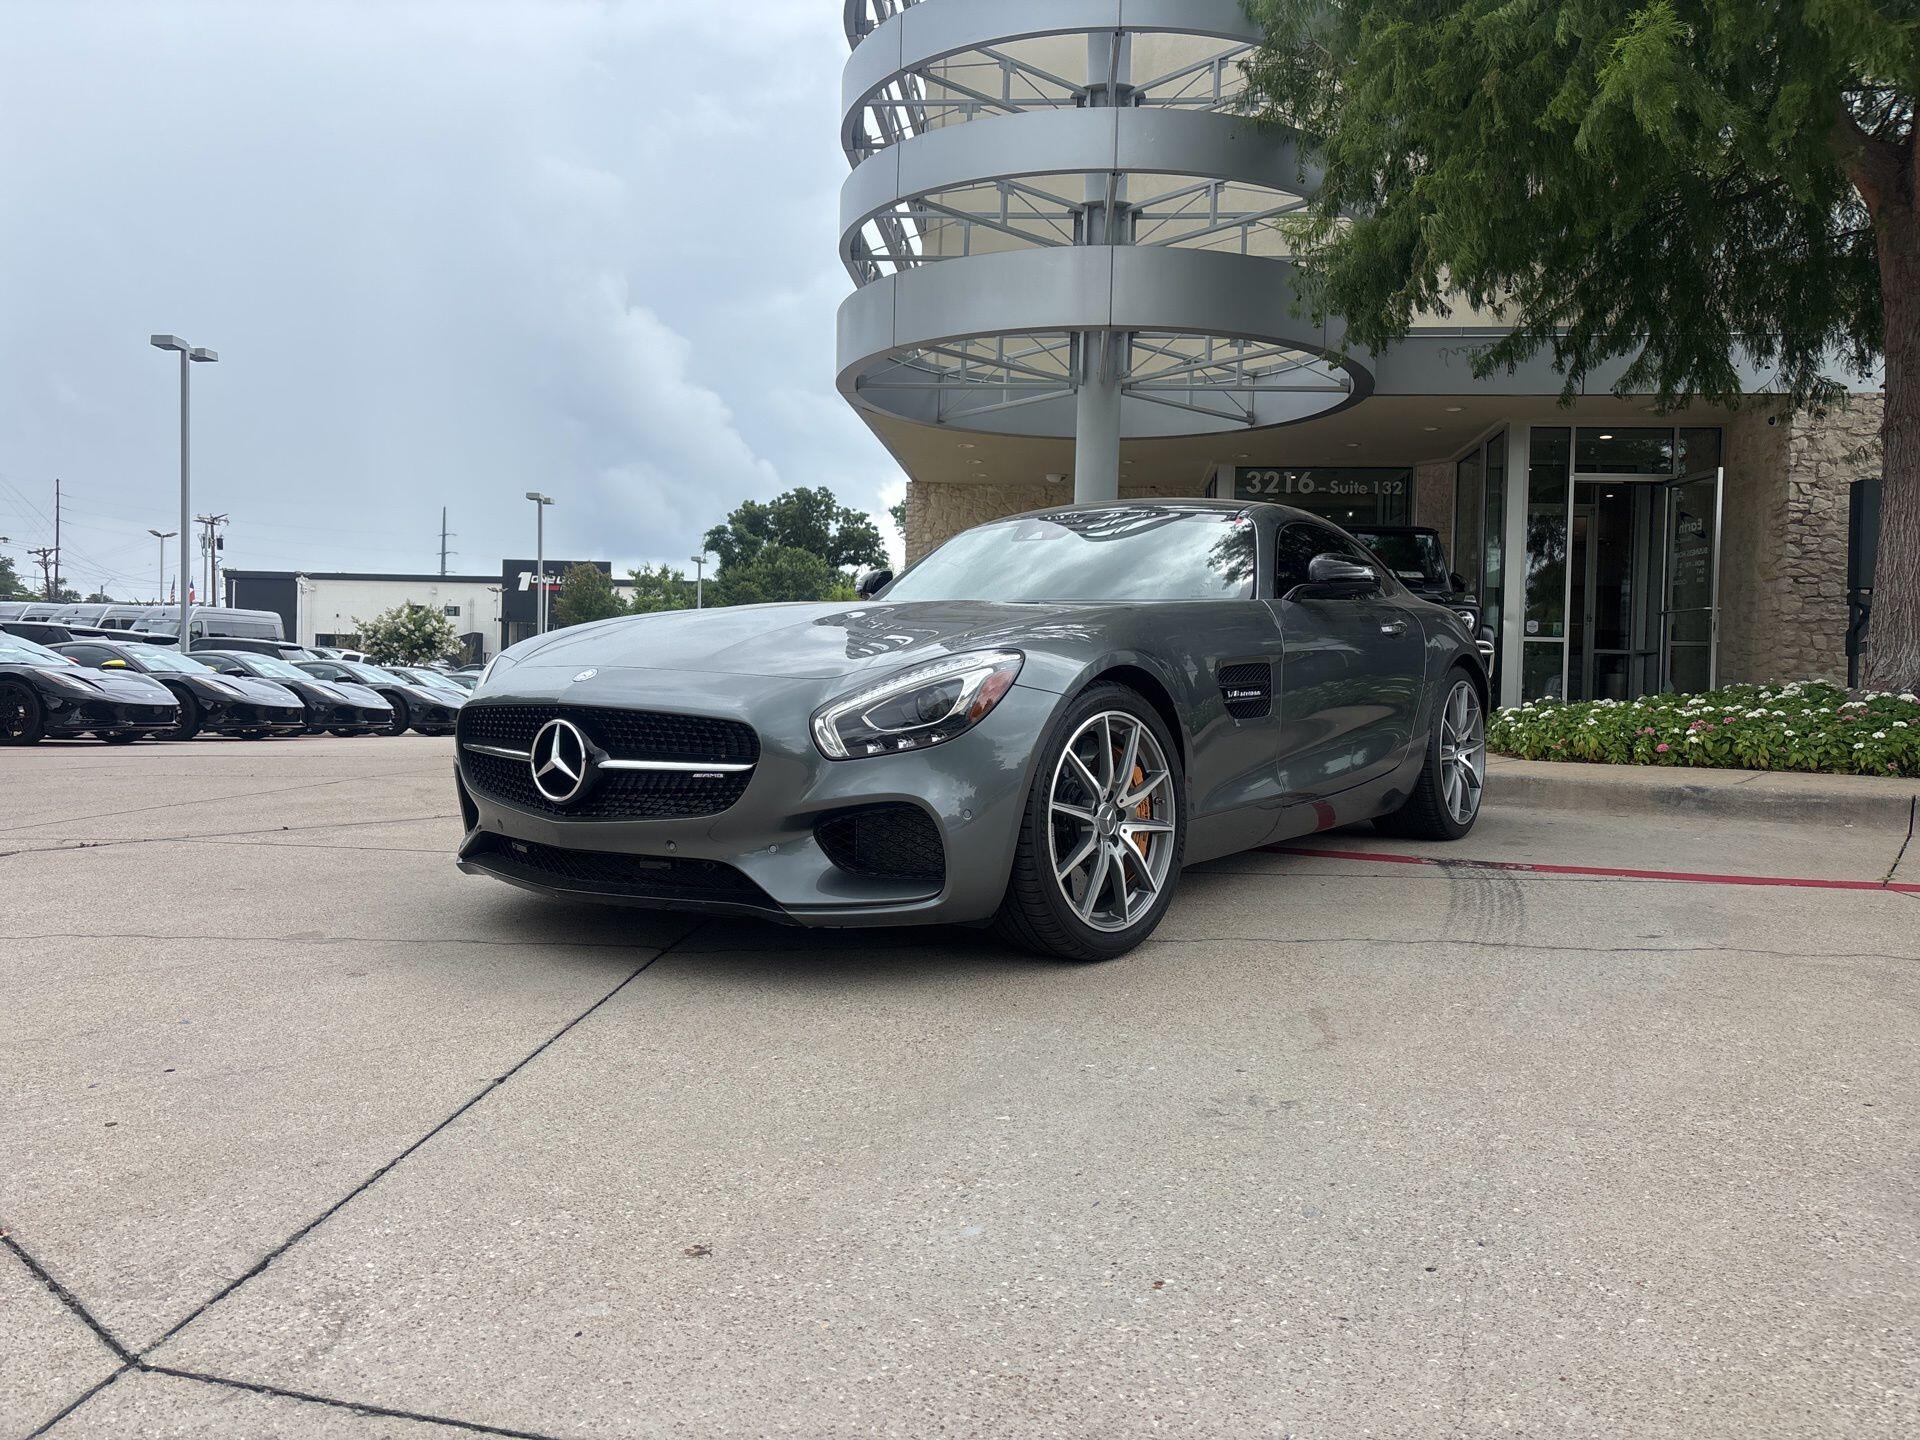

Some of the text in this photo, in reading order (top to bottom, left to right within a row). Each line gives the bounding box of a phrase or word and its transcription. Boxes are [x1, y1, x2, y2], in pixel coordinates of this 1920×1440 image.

[1246, 471, 1315, 494] 3216
[1330, 480, 1369, 494] Suite
[1374, 480, 1403, 495] 132
